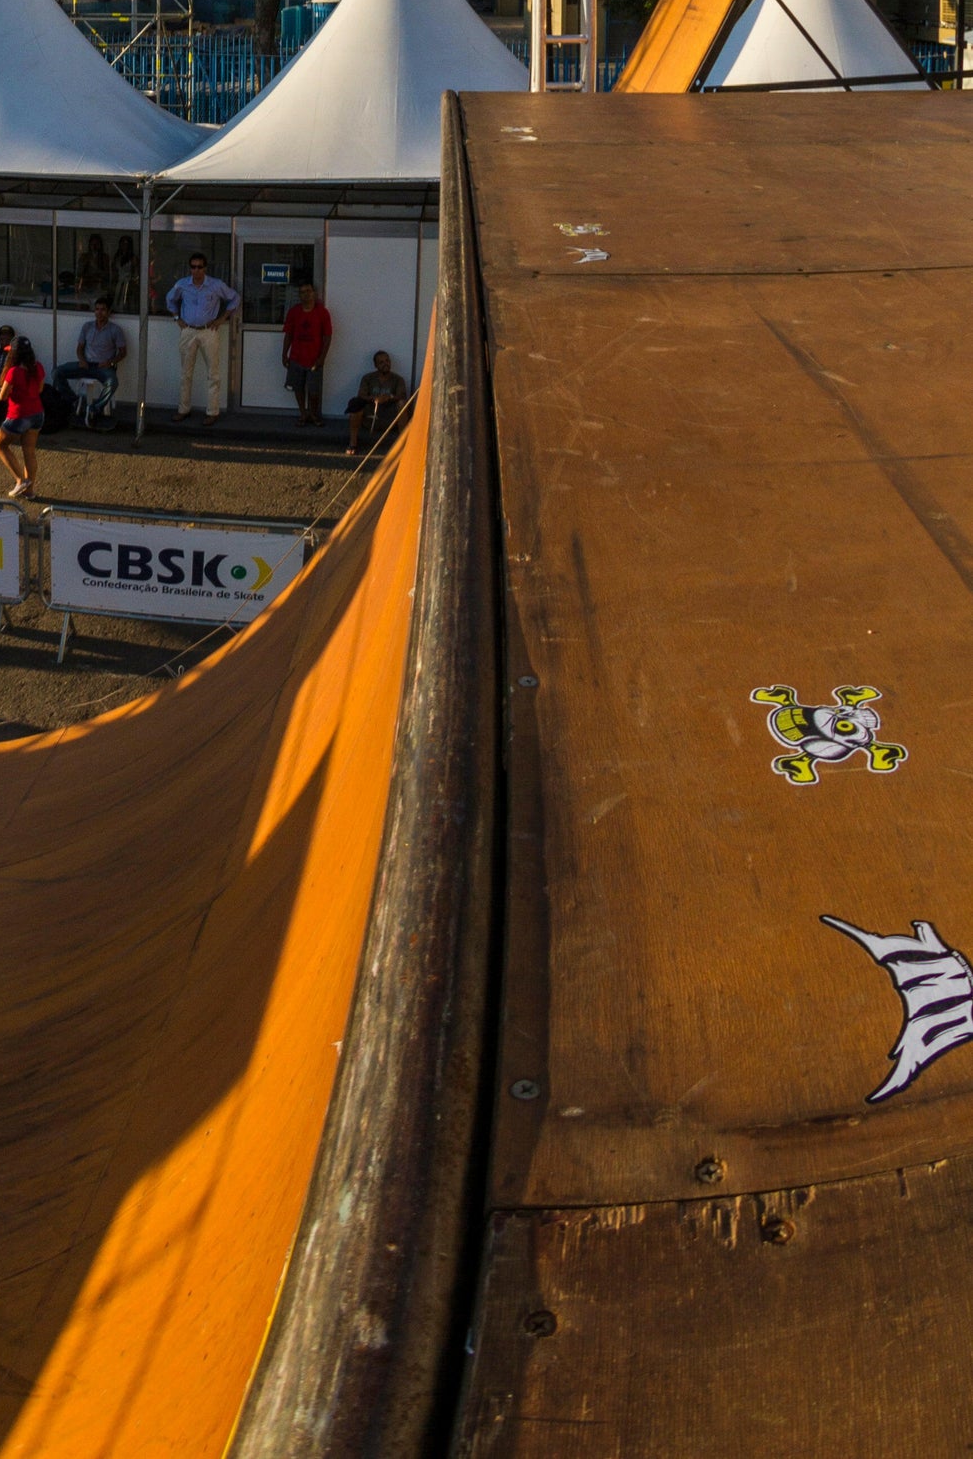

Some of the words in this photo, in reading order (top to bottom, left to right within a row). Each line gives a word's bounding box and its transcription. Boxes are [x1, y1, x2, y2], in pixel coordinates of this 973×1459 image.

[77, 540, 229, 589] CBSK
[82, 577, 158, 594] Confederação
[162, 585, 213, 599] Brasileira
[216, 590, 231, 600] de
[233, 591, 265, 602] Skate
